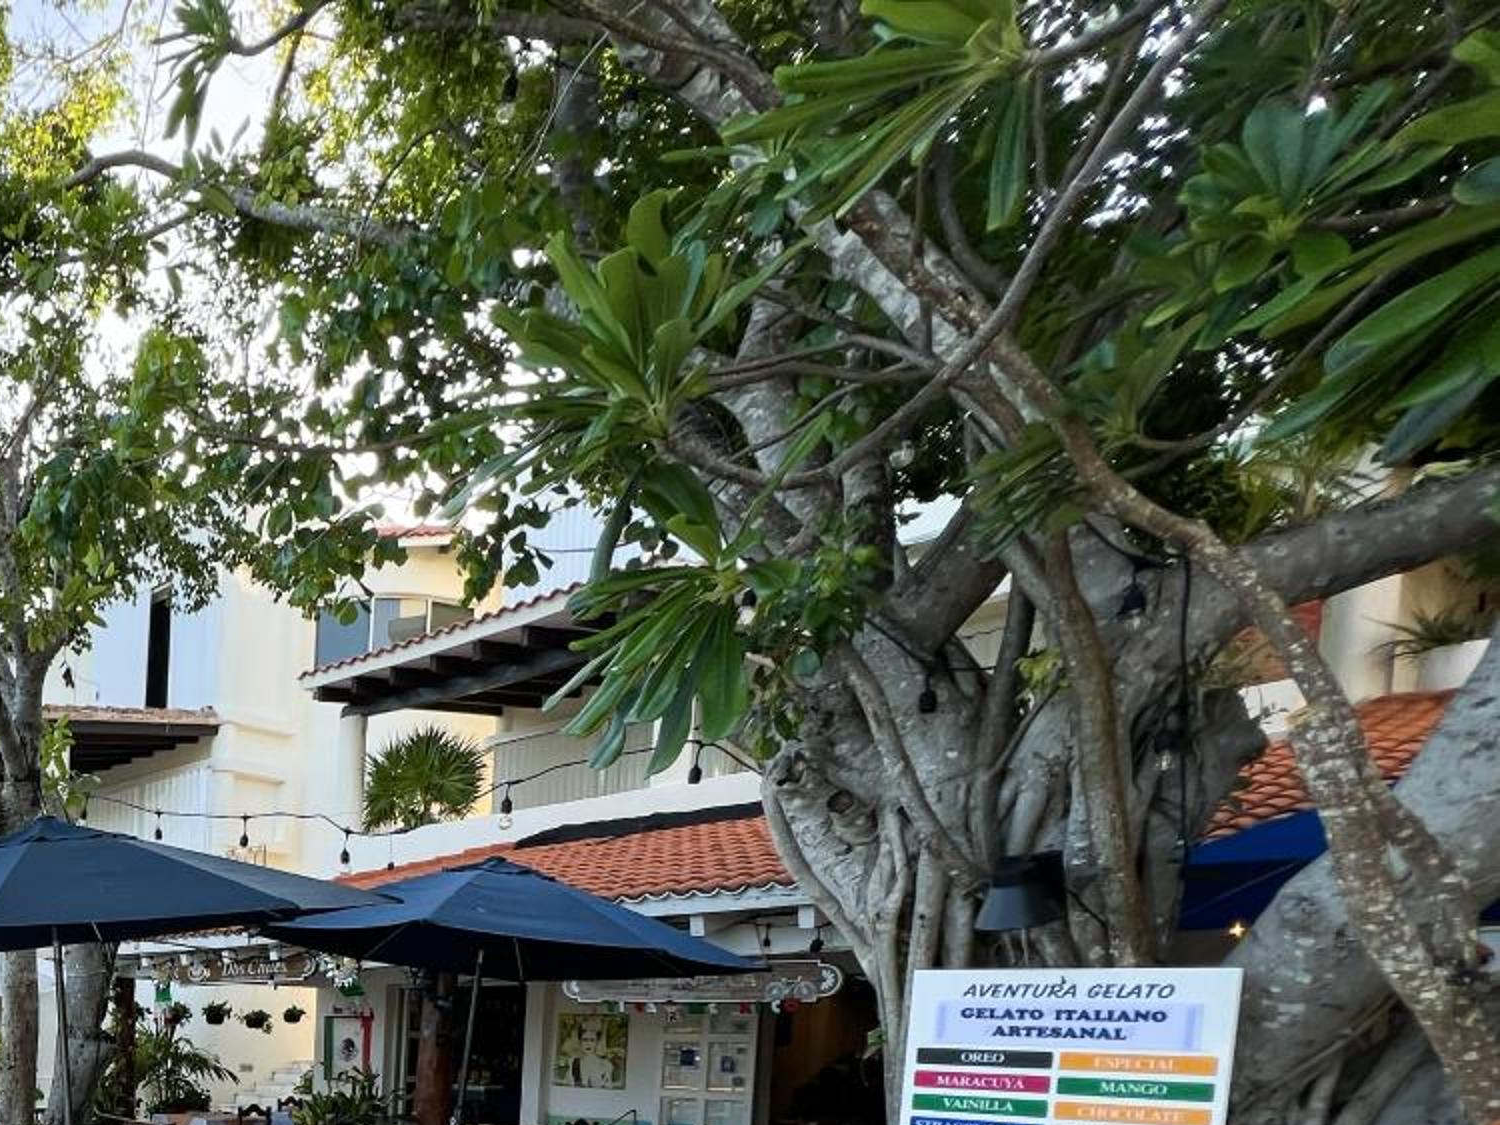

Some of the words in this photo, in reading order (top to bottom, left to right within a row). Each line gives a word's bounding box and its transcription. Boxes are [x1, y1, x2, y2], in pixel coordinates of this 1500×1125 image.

[963, 983, 1077, 999] AVENTURA
[1087, 983, 1175, 999] GELATO
[960, 1007, 1044, 1021] GELATO
[1054, 1009, 1167, 1023] ITALIANO
[991, 1026, 1127, 1040] ARTESANAL
[961, 1051, 1005, 1063] OREO
[1094, 1057, 1178, 1071] ESPECIAL
[937, 1075, 1025, 1090] MARACUYA
[1100, 1081, 1169, 1095] MANGO
[943, 1097, 1014, 1112] VAINILLA
[1076, 1106, 1184, 1123] CHOCOLATE
